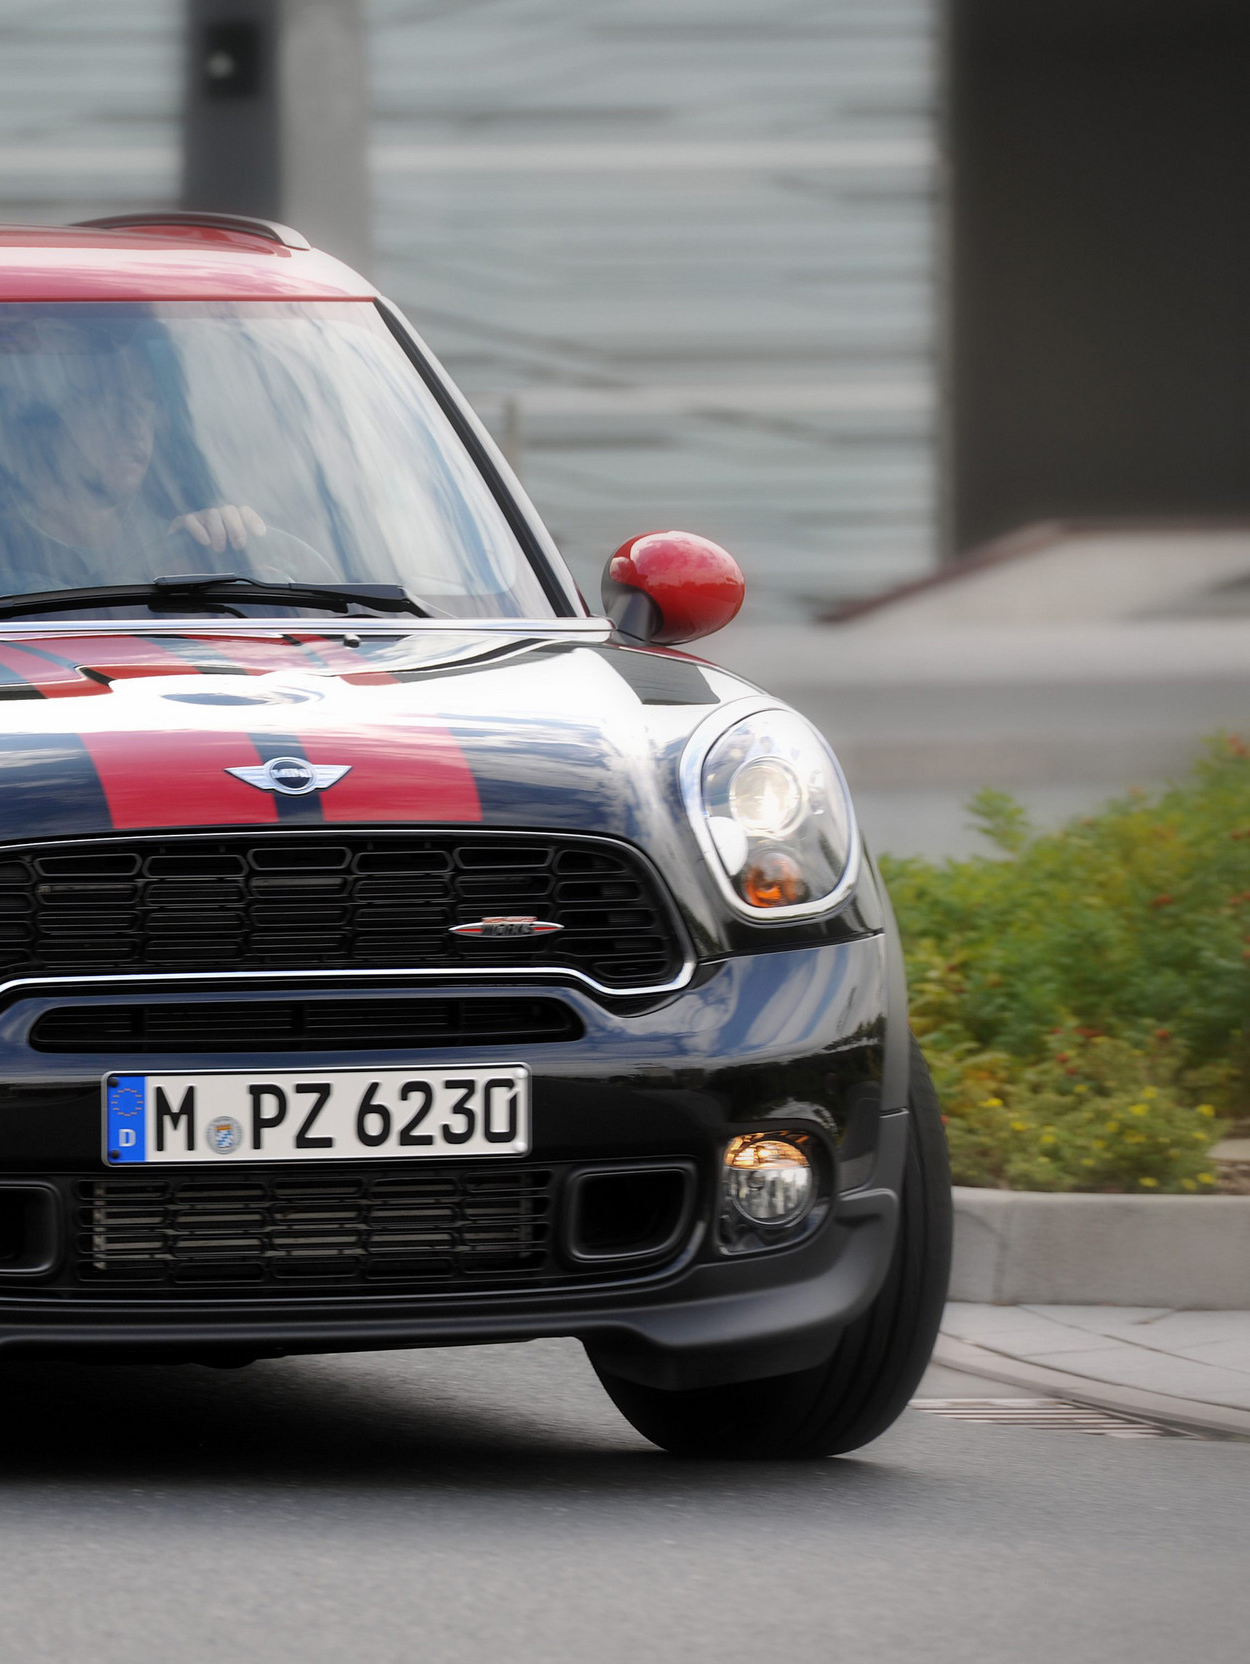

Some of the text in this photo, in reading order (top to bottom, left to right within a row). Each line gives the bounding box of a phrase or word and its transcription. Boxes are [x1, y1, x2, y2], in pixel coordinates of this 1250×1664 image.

[118, 1129, 137, 1147] D
[154, 1084, 196, 1152] M
[249, 1082, 334, 1150] PZ
[356, 1078, 520, 1148] 6230
